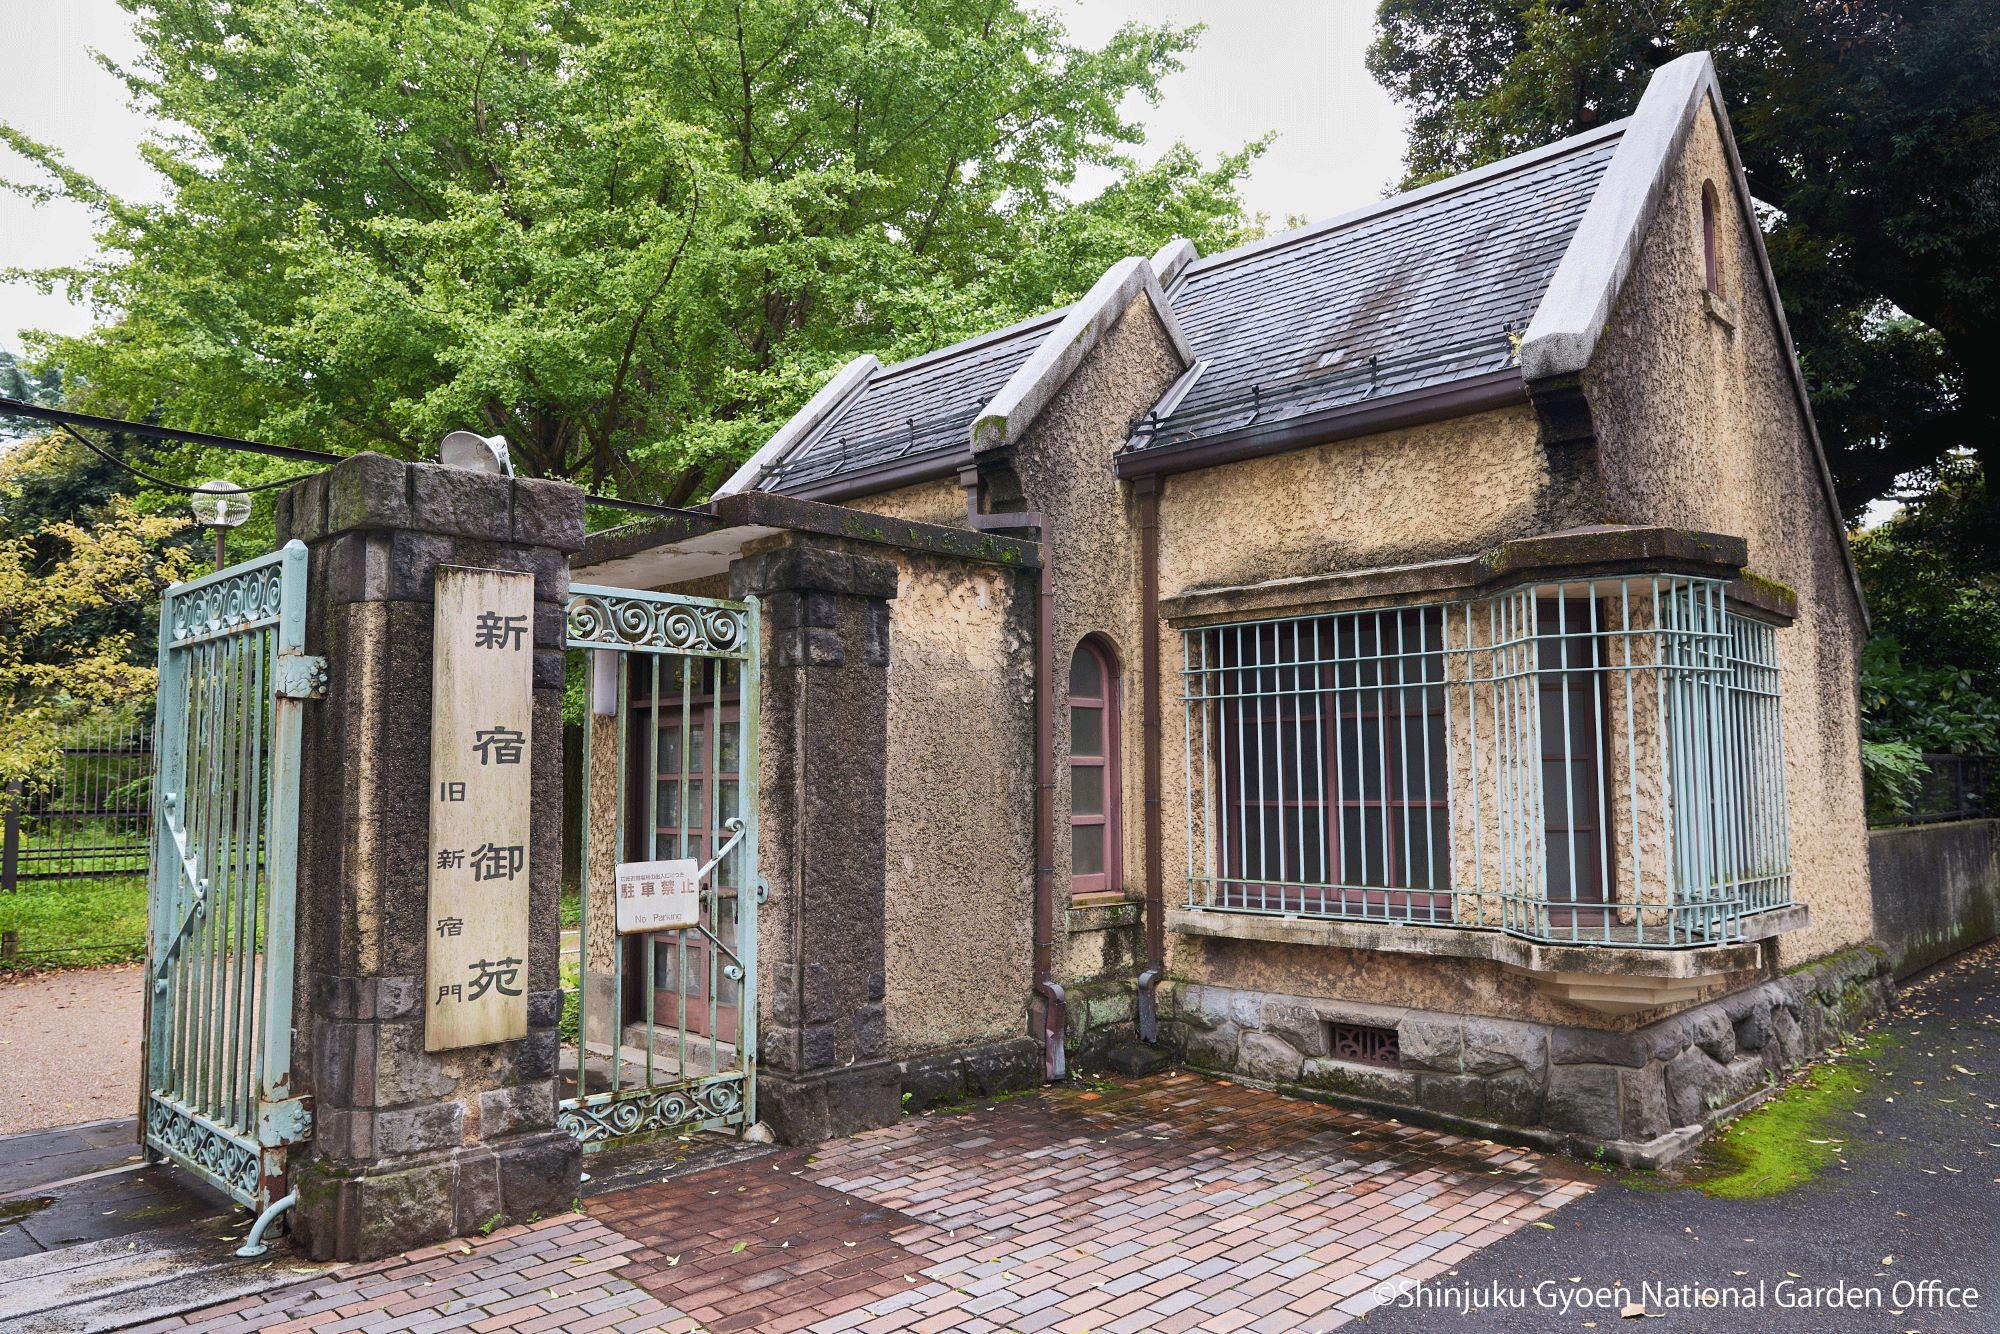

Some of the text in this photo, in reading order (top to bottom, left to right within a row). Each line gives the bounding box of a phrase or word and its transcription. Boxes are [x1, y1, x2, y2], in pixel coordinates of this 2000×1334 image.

[468, 610, 529, 997] 新宿御苑
[435, 781, 466, 1006] 旧新宿門
[620, 879, 695, 899] 駐車禁止
[634, 912, 682, 924] No Parking
